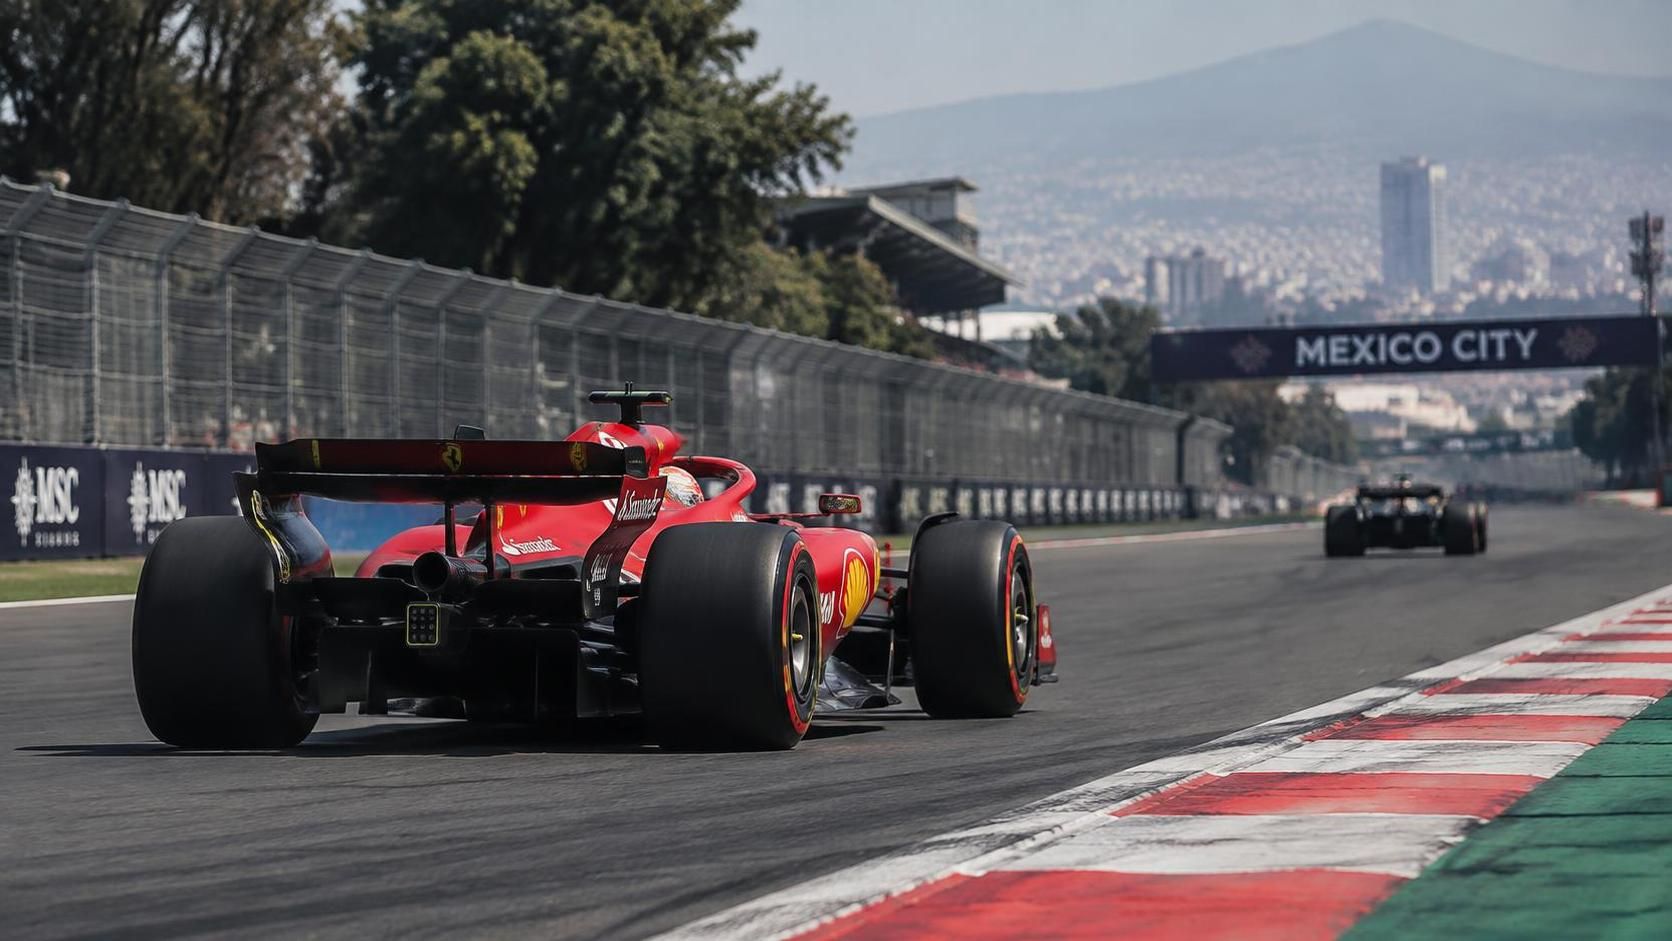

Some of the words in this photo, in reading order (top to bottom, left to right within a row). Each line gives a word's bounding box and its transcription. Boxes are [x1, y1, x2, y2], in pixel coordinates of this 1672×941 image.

[1295, 331, 1443, 367] MEXICO
[1452, 328, 1539, 362] CITY
[35, 466, 80, 524] MSC
[147, 469, 187, 522] MSC
